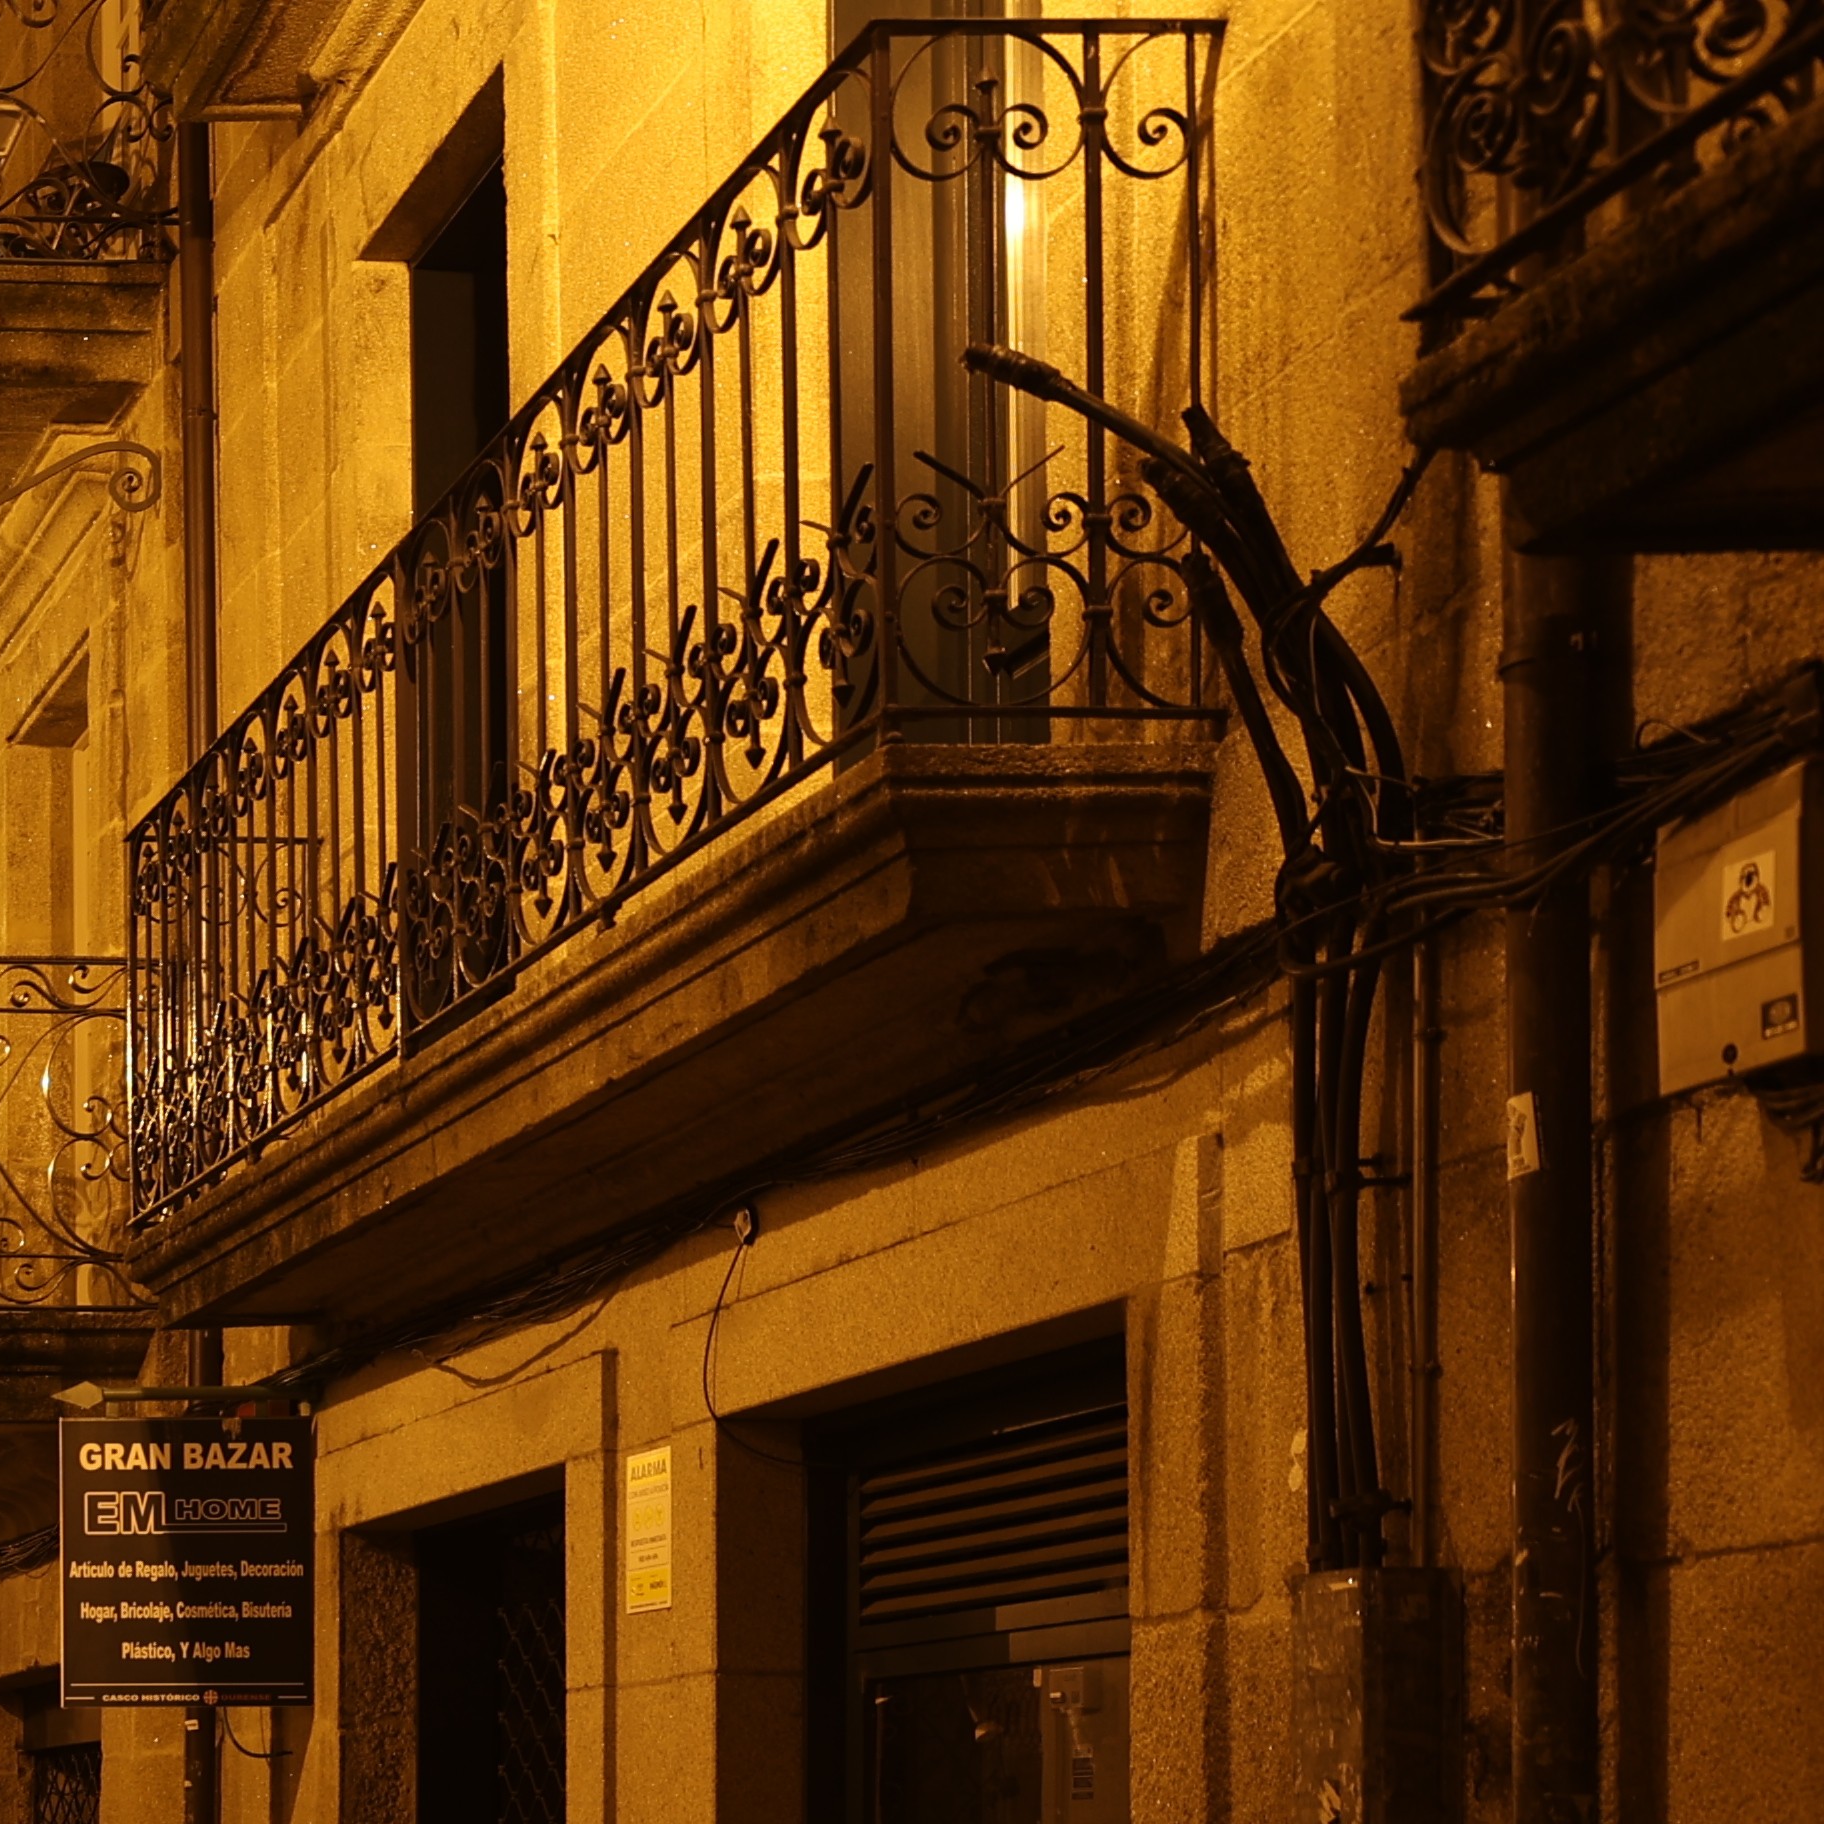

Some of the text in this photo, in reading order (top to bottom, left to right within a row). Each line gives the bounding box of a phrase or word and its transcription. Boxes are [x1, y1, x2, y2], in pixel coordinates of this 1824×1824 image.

[79, 1441, 295, 1471] GRAN BAZAR
[630, 1459, 668, 1482] ALARMA
[83, 1490, 282, 1536] EM HOME
[69, 1559, 304, 1582] Artículo de Regalo, Juguetes, Decoración
[80, 1600, 293, 1624] Hogar, Bricolaje, Cosmética, Bisutería
[121, 1641, 251, 1663] Plástico, Y Algo Mas
[102, 1693, 139, 1703] CASCO
[141, 1691, 200, 1703] HISTÓRICO
